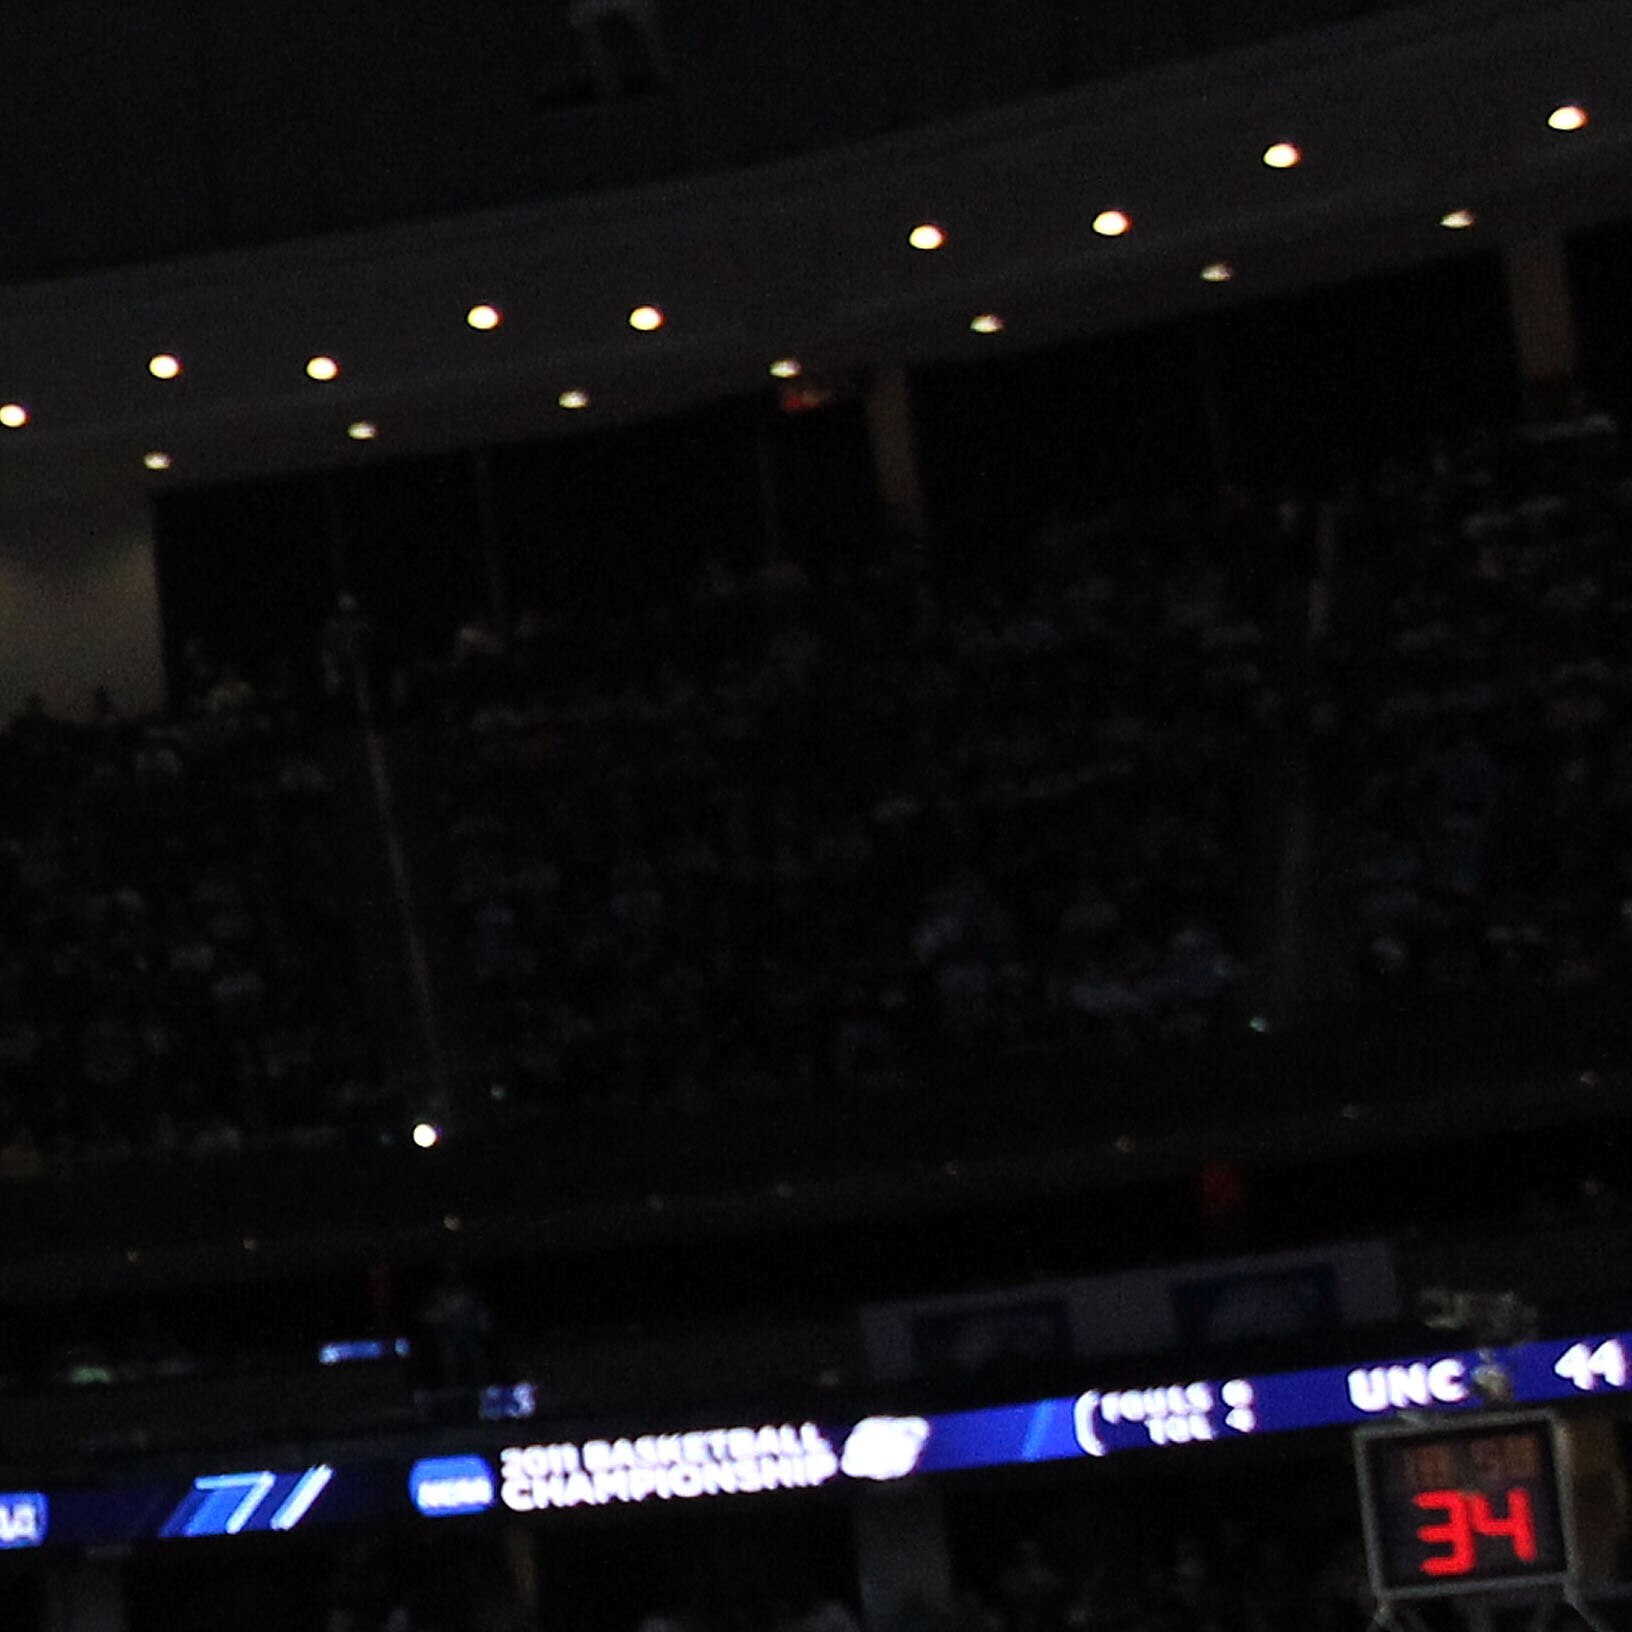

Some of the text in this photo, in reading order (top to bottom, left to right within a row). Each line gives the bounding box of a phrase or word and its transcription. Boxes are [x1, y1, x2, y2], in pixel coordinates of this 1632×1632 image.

[1348, 1337, 1629, 1413] UNC 44
[502, 1452, 837, 1512] CHAMPIONSHIP
[1412, 1487, 1539, 1577] 34
